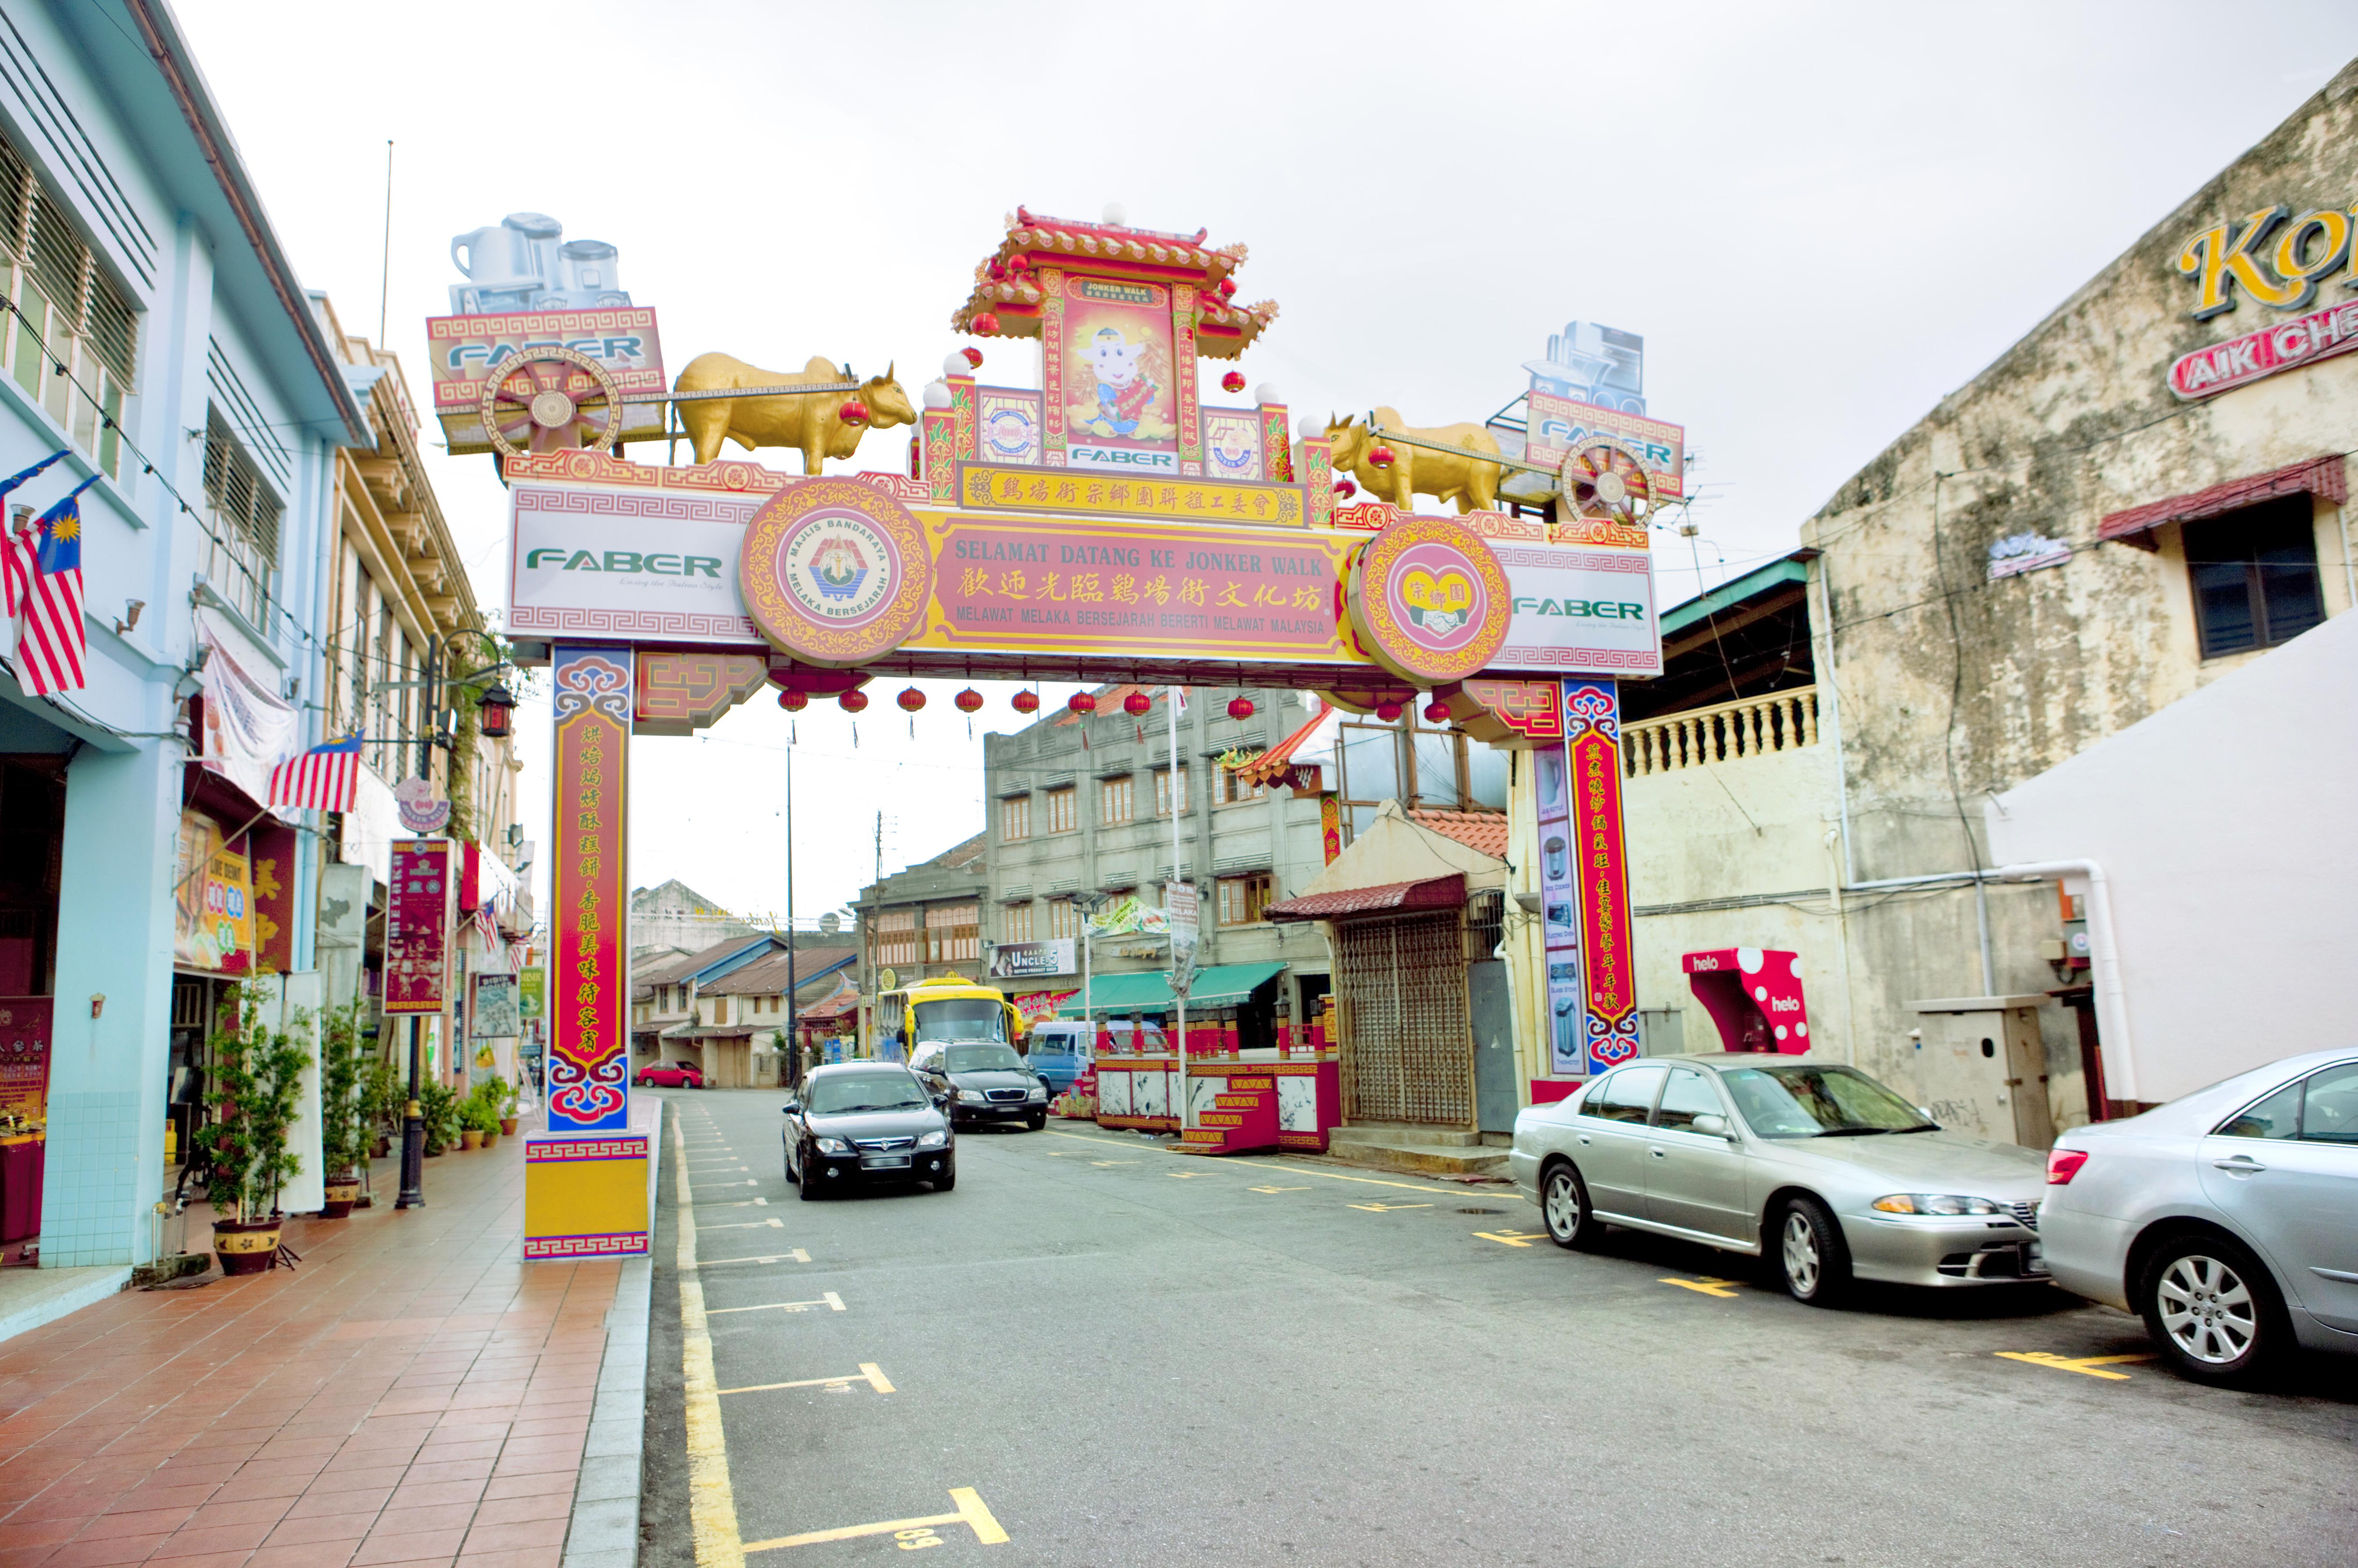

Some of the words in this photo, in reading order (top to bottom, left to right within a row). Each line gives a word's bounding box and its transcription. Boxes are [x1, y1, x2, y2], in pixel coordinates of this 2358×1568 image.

[1087, 283, 1121, 293] JONKER
[1124, 287, 1147, 296] WALK
[2185, 340, 2260, 389] AIK
[1072, 448, 1172, 467] FABER
[790, 523, 822, 557] MAJLIS
[827, 519, 886, 562] BANDARAYA
[527, 548, 722, 578] FABER
[956, 540, 1049, 563] SELAMAT
[1061, 545, 1140, 567] DATANG
[1150, 549, 1175, 569] KE
[1186, 551, 1262, 572] JONKER
[1272, 555, 1323, 577] WALK
[789, 572, 821, 612] MELAKA
[826, 576, 888, 616] BERSEJARAH
[956, 606, 1014, 622] MELAWAT
[1021, 608, 1071, 625] MELAKA
[1077, 611, 1155, 627] BERSEJARAH
[1160, 614, 1209, 629] BERERTI
[1213, 616, 1265, 632] MELAWAT
[1271, 619, 1325, 634] MALAYSIA
[1512, 597, 1644, 620] FABER
[1170, 907, 1198, 917] MELAKA
[1693, 955, 1718, 971] helo
[1771, 995, 1800, 1012] helo
